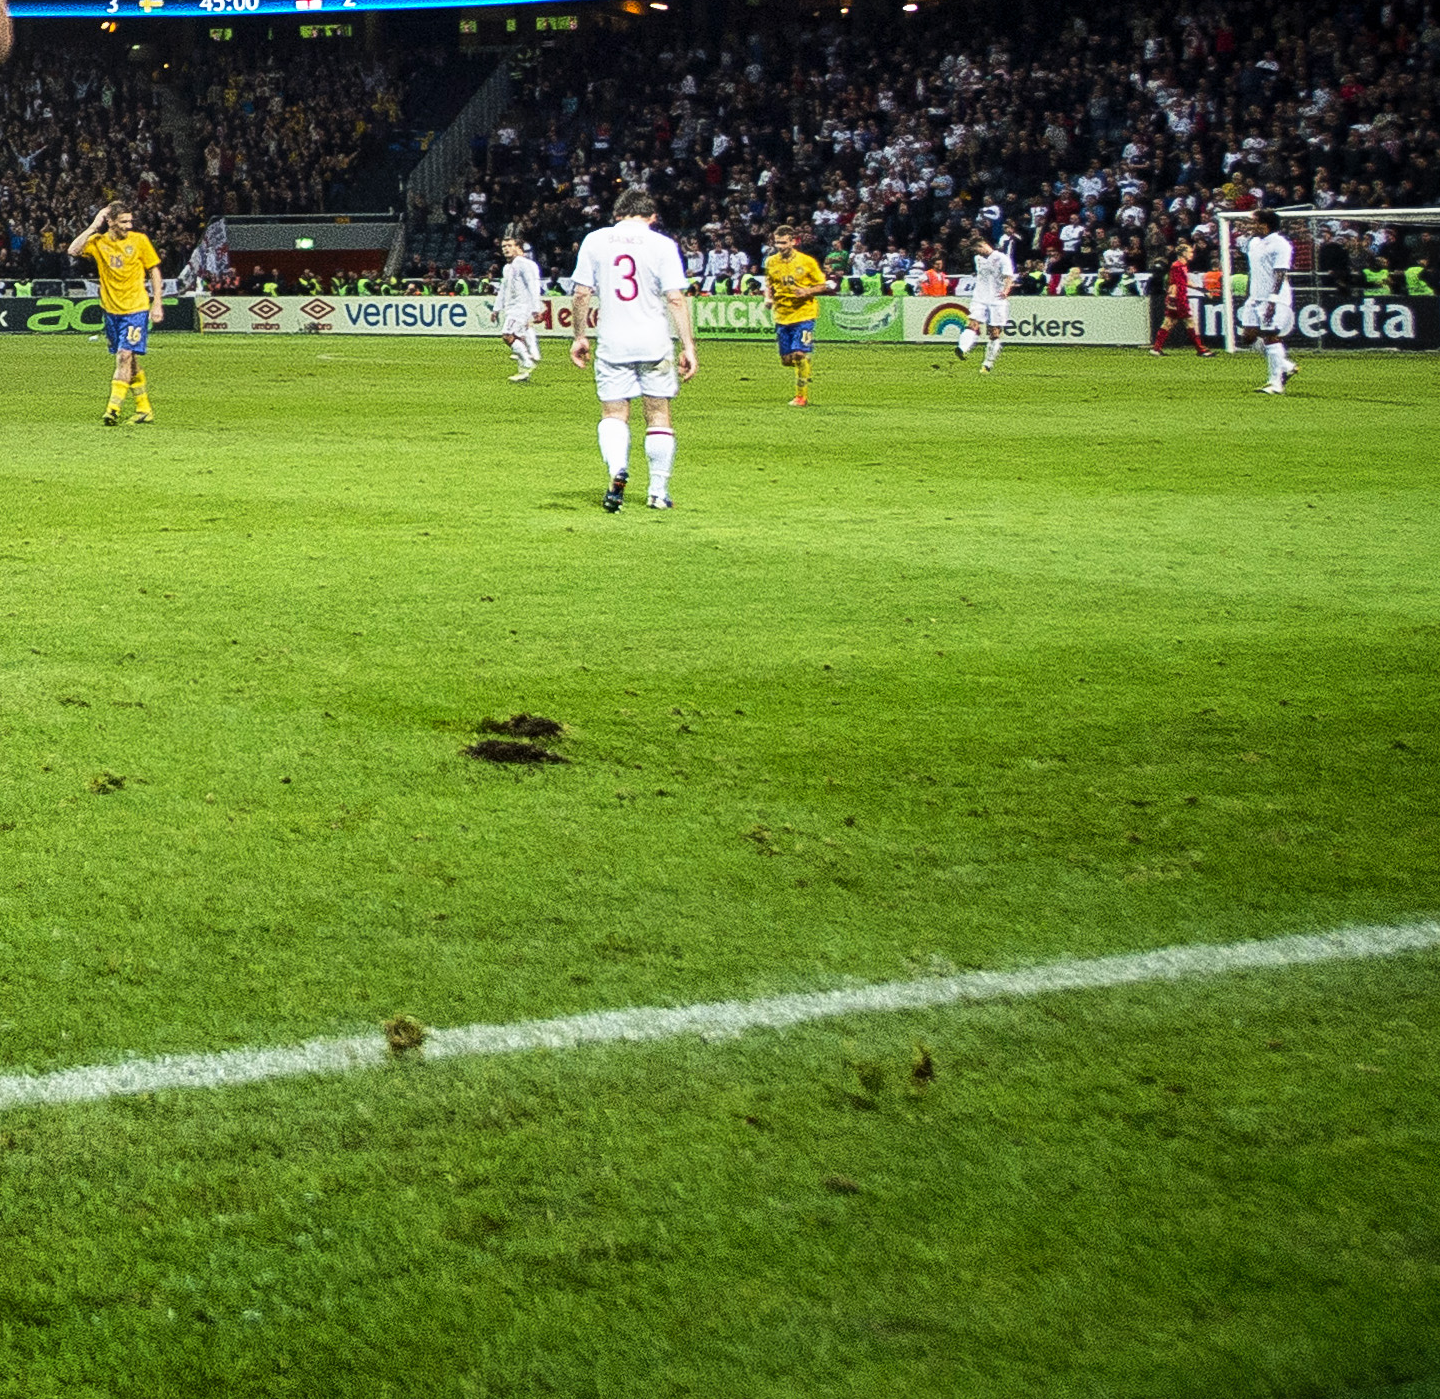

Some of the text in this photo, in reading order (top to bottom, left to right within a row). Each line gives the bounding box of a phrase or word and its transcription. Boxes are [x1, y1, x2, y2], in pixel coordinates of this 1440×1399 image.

[613, 253, 638, 301] 3
[251, 322, 280, 330] umbro
[344, 303, 467, 327] verisure
[986, 313, 1086, 337] eckers
[126, 325, 142, 345] 16
